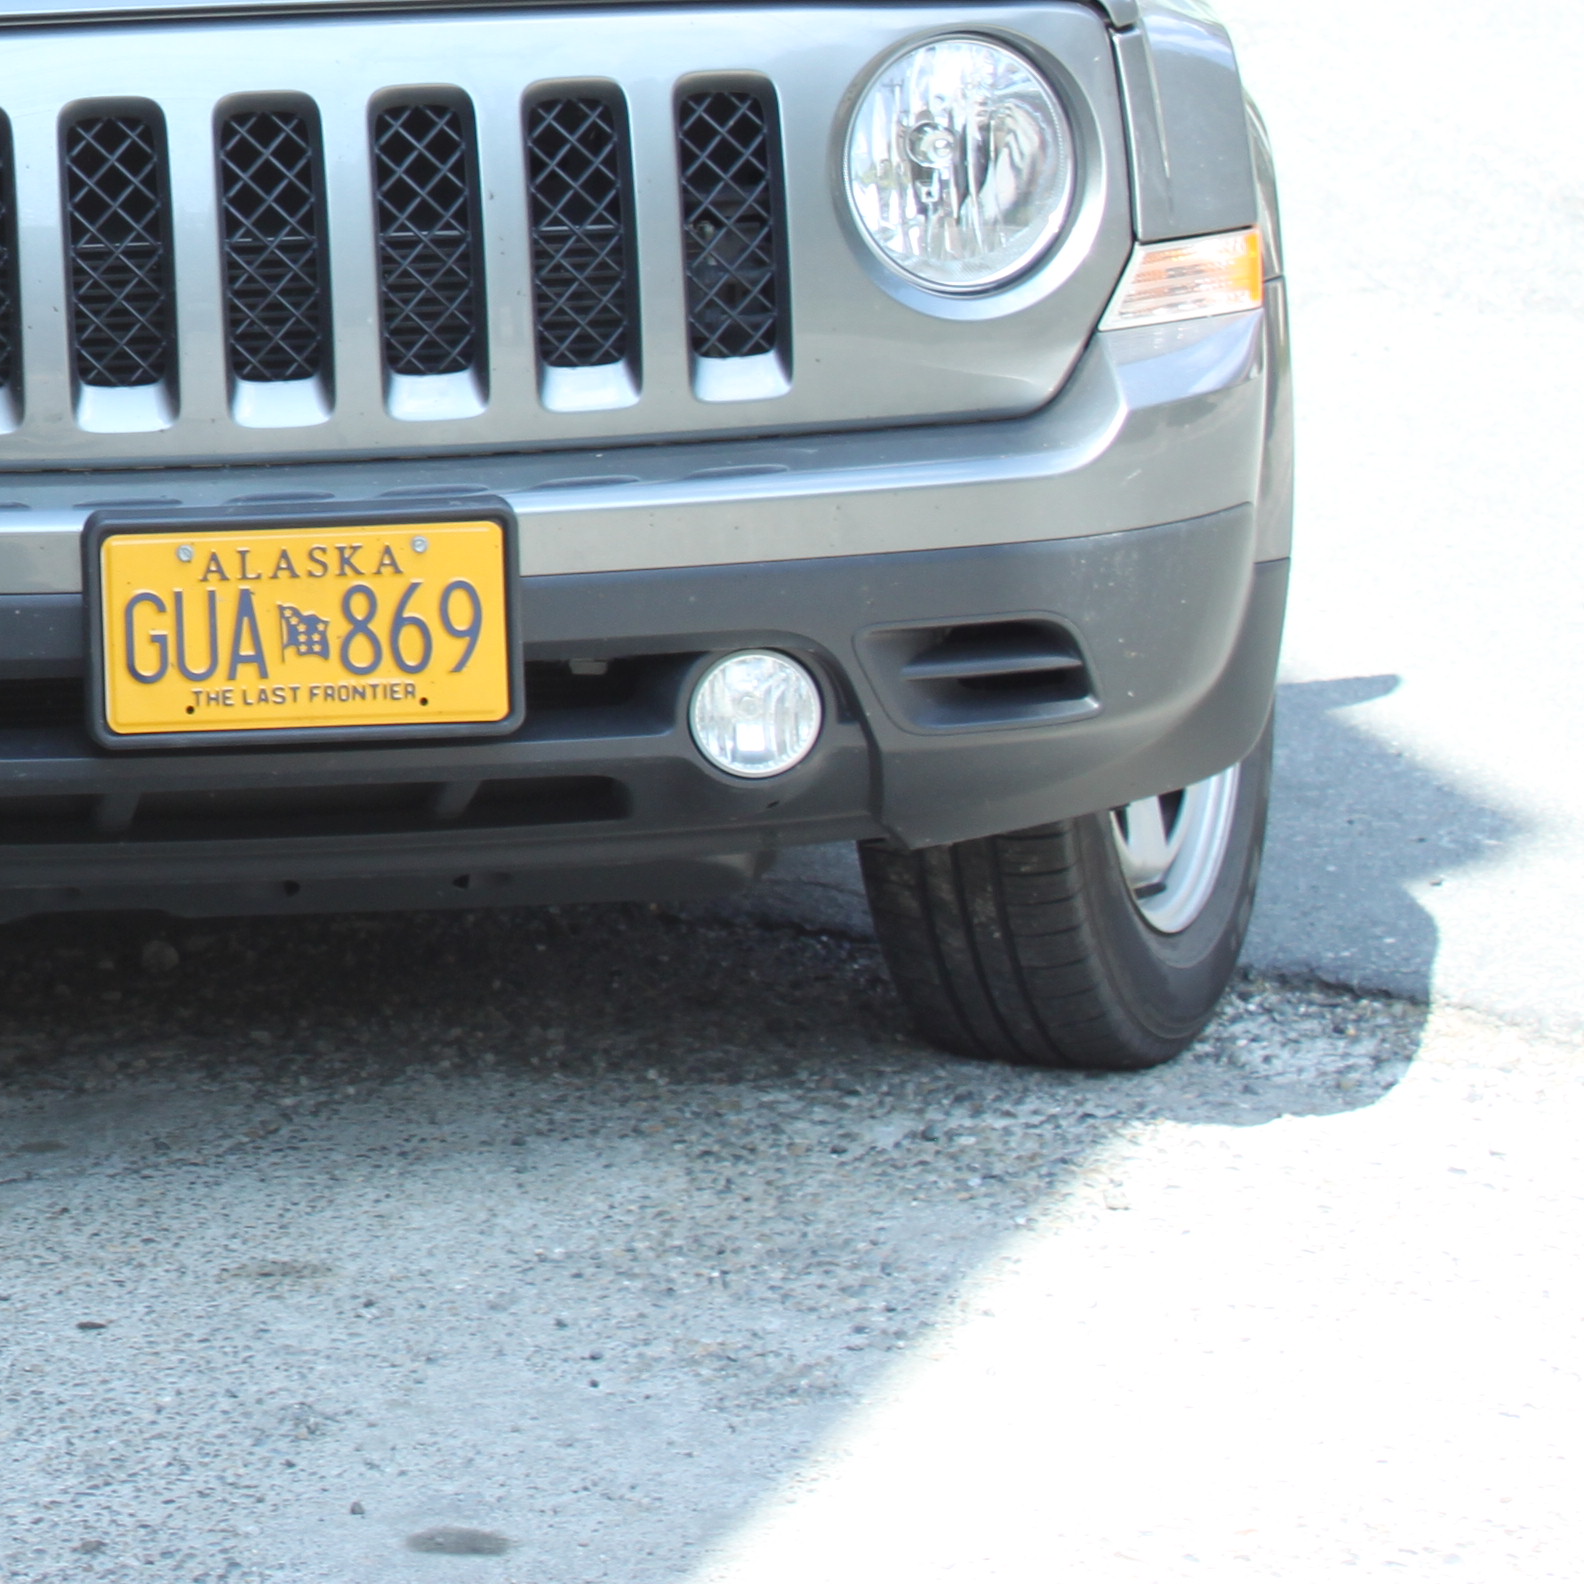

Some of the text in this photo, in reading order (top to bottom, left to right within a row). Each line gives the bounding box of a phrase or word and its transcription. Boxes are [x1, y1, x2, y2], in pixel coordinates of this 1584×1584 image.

[199, 544, 403, 583] ALASKA
[125, 579, 483, 684] GUA 869
[190, 681, 416, 707] THE LAST FRONTIER
